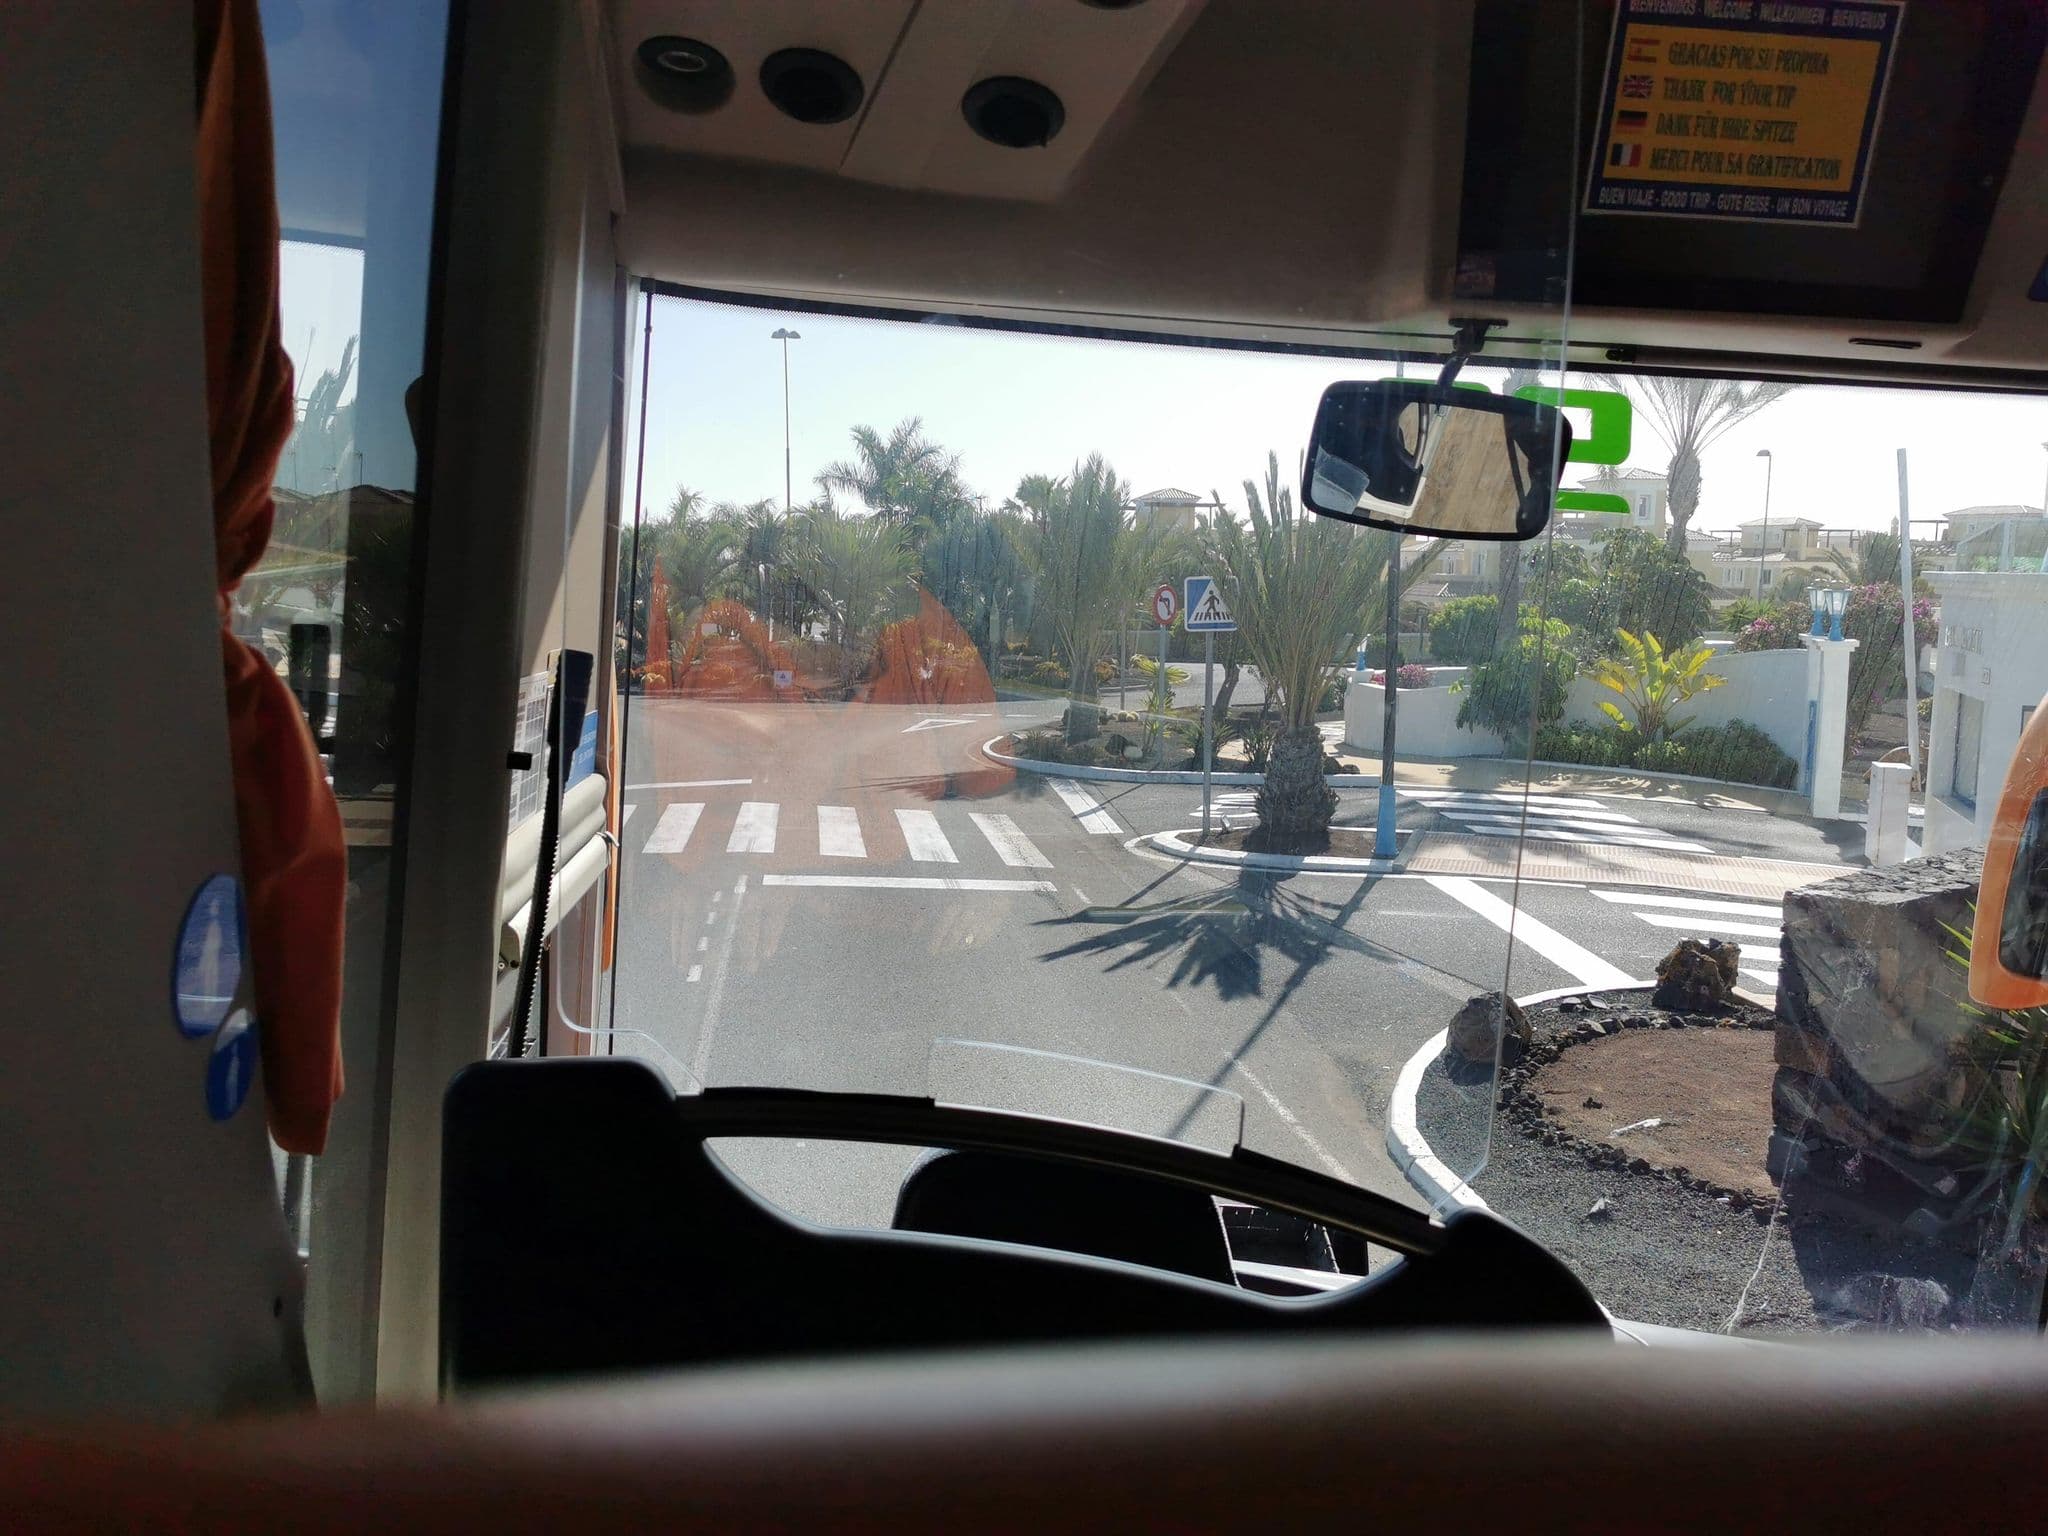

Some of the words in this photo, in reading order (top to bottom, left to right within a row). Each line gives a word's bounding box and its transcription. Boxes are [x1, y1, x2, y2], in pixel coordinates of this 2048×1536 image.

[1703, 0, 1753, 20] WELCOME
[1760, 2, 1826, 25] WILLKOMMEN
[1668, 41, 1729, 68] GRACIAS
[1727, 45, 1755, 70] POR
[1755, 47, 1776, 72] SU
[1774, 49, 1830, 74] PROPINA
[1663, 77, 1706, 102] THANK
[1711, 80, 1737, 105] FOR
[1740, 80, 1774, 107] YOUR
[1775, 84, 1797, 109] TIP
[1656, 112, 1692, 136] DANK
[1751, 120, 1797, 142] SPITZE
[1649, 147, 1690, 172] MERCI
[1690, 150, 1725, 174] POUR
[1745, 153, 1842, 180] GRATIFICATION
[1599, 186, 1626, 206] BUEN
[1626, 187, 1656, 207] VIAJE
[1661, 189, 1688, 209] GOOD
[1688, 190, 1712, 210] TRIP
[1717, 193, 1744, 211] GUTE
[1743, 194, 1770, 213] REISE
[1811, 199, 1849, 218] VOYAGE
